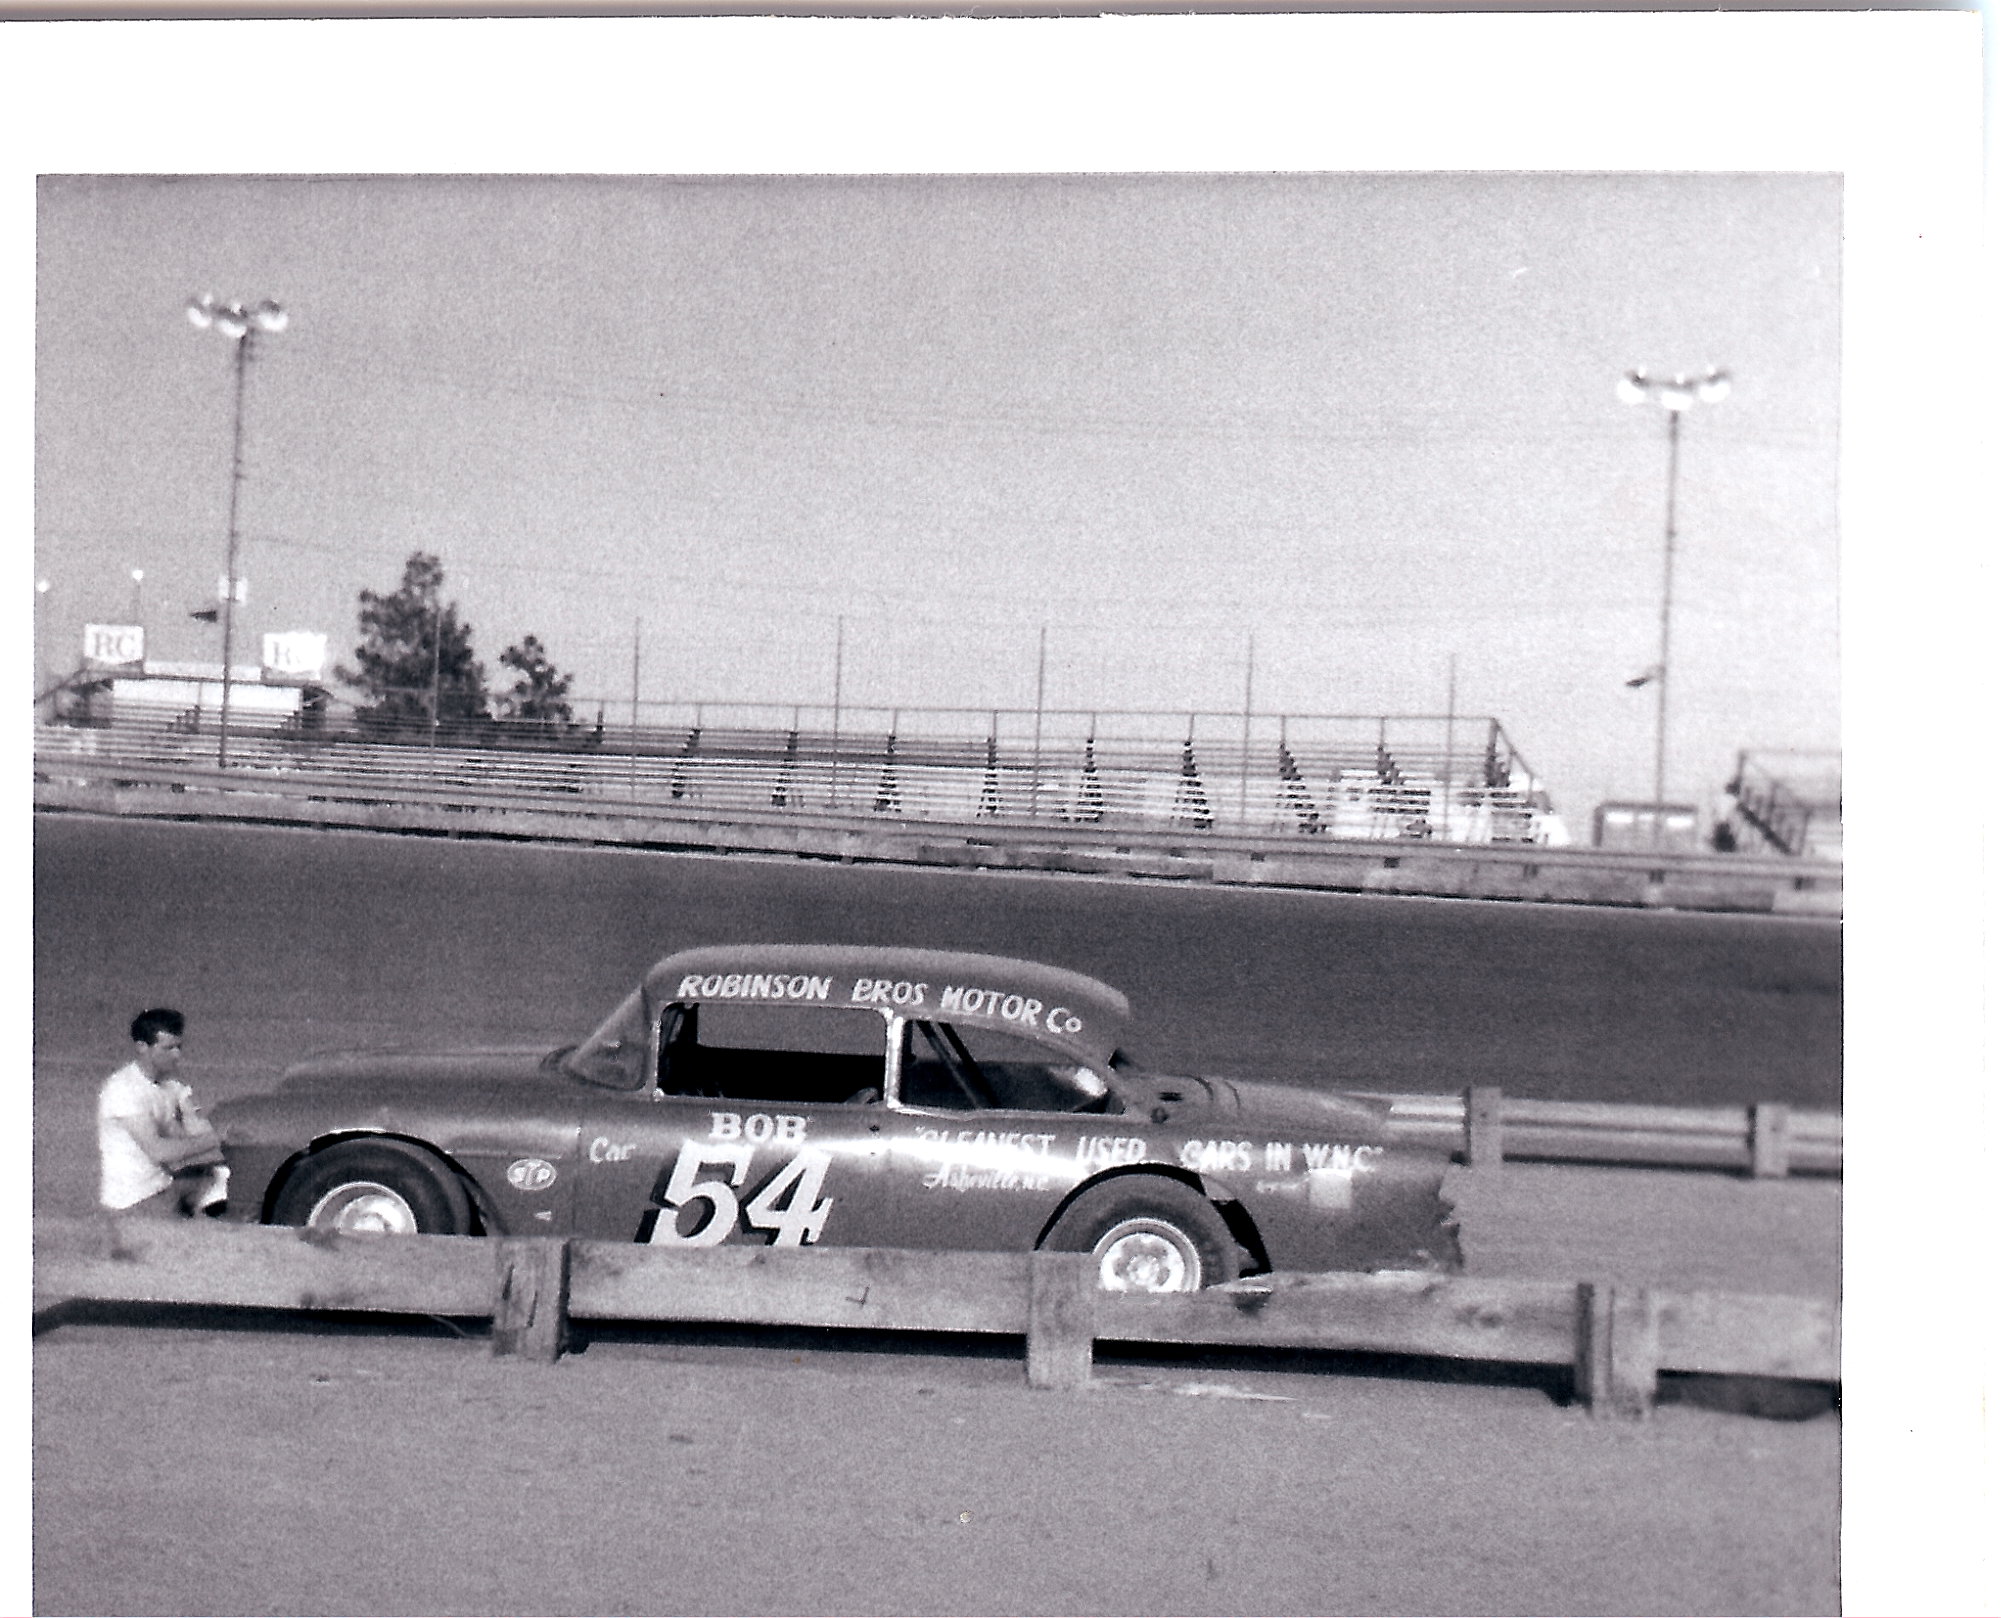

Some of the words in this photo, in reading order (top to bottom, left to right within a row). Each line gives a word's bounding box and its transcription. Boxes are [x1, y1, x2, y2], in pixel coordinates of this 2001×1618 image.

[677, 974, 833, 999] ROBINSON
[852, 978, 928, 1006] BROS
[940, 985, 1043, 1026] MOTOR
[1046, 1006, 1083, 1034] Co
[708, 1112, 811, 1145] BOB
[589, 1136, 637, 1164] Car
[1075, 1136, 1148, 1162] USED
[1179, 1139, 1253, 1173] CARS
[1264, 1142, 1292, 1172] IN
[646, 1138, 835, 1247] 54
